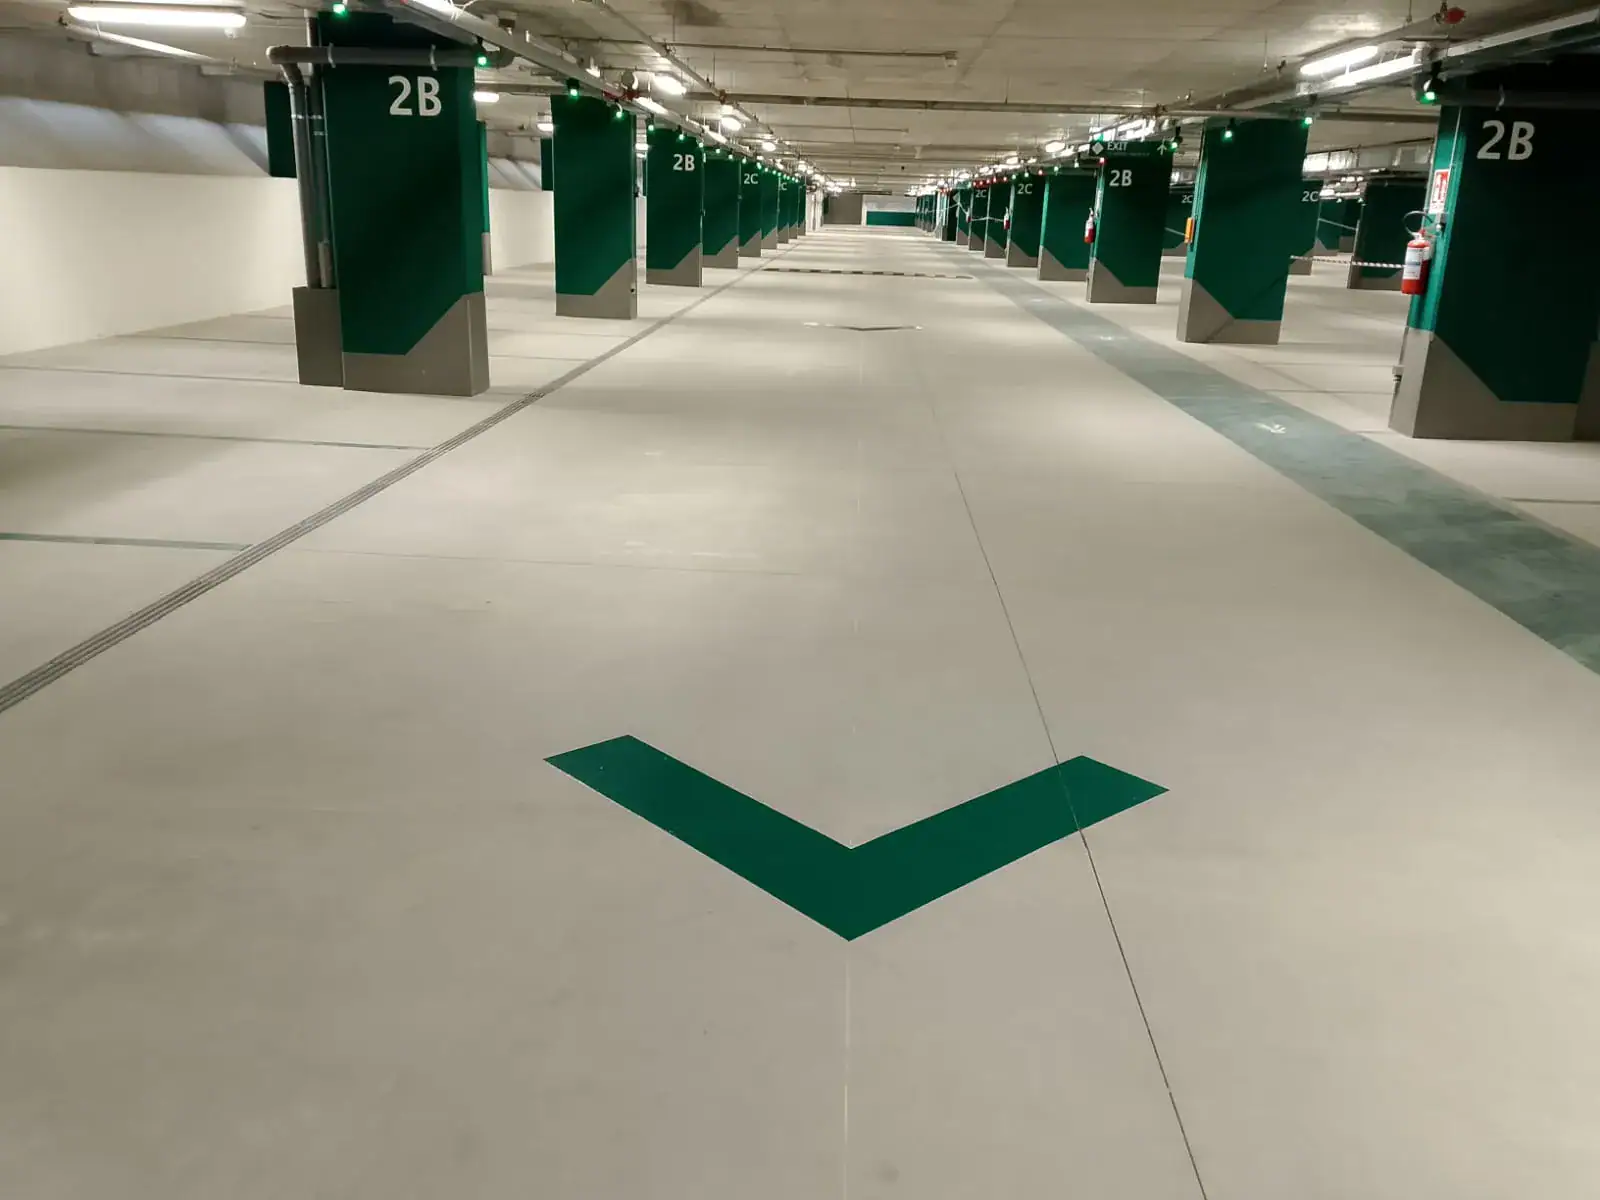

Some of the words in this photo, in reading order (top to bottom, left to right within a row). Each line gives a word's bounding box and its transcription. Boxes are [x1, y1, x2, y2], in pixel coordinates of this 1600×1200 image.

[388, 75, 442, 116] 2B
[1107, 141, 1128, 151] EXIT
[1476, 119, 1536, 161] 2B
[673, 153, 695, 172] 2B
[744, 173, 759, 185] 2C
[1109, 169, 1132, 187] 2B
[1017, 183, 1033, 195] 2C
[1302, 190, 1319, 202] 2C
